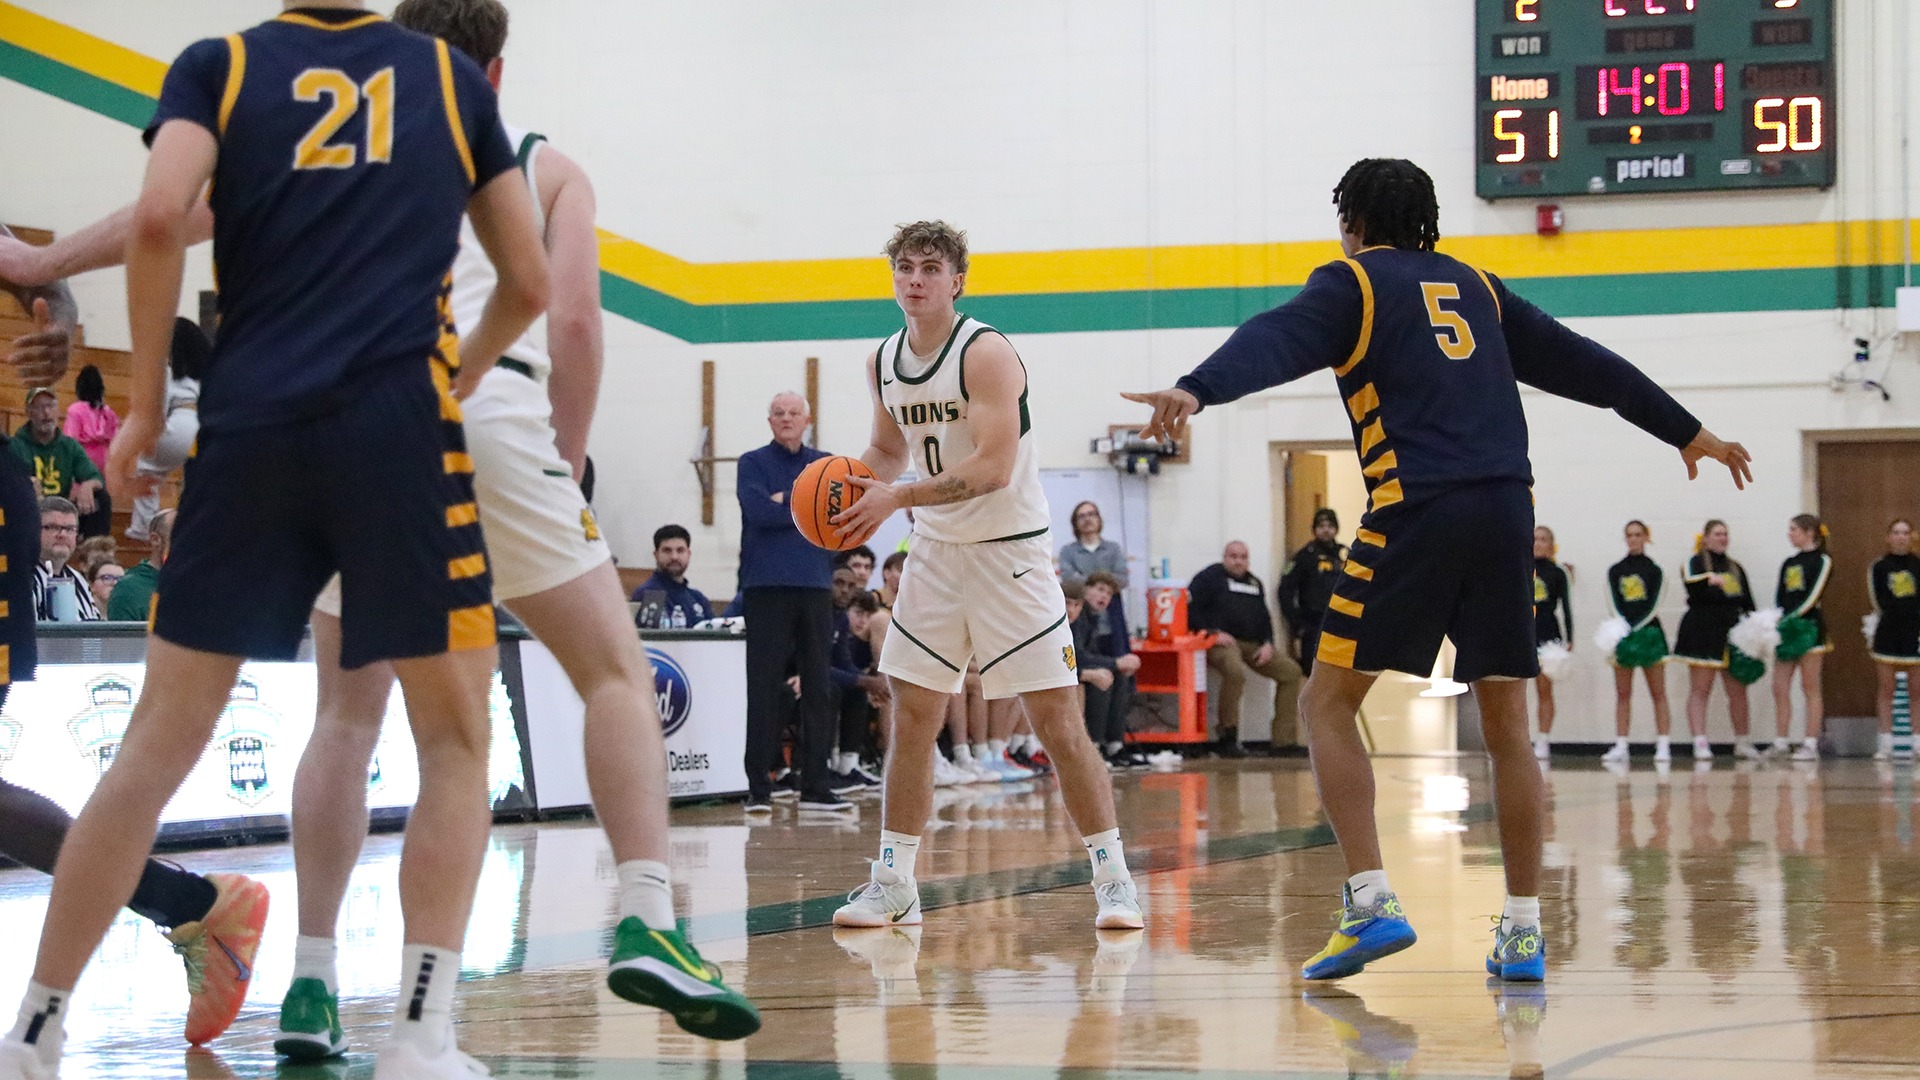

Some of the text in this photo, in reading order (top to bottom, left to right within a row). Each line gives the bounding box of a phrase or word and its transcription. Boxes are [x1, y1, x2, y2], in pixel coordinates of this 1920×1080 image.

[1501, 36, 1541, 55] won
[1491, 75, 1549, 101] Home
[1597, 62, 1724, 116] 14:01
[292, 66, 394, 169] 21
[1628, 125, 1642, 144] 2
[1753, 96, 1822, 152] 50
[1493, 109, 1559, 163] 51
[1616, 154, 1685, 183] period
[1419, 281, 1476, 359] 5
[888, 400, 961, 426] LIONS
[922, 434, 944, 477] 0
[669, 749, 710, 771] Dealers
